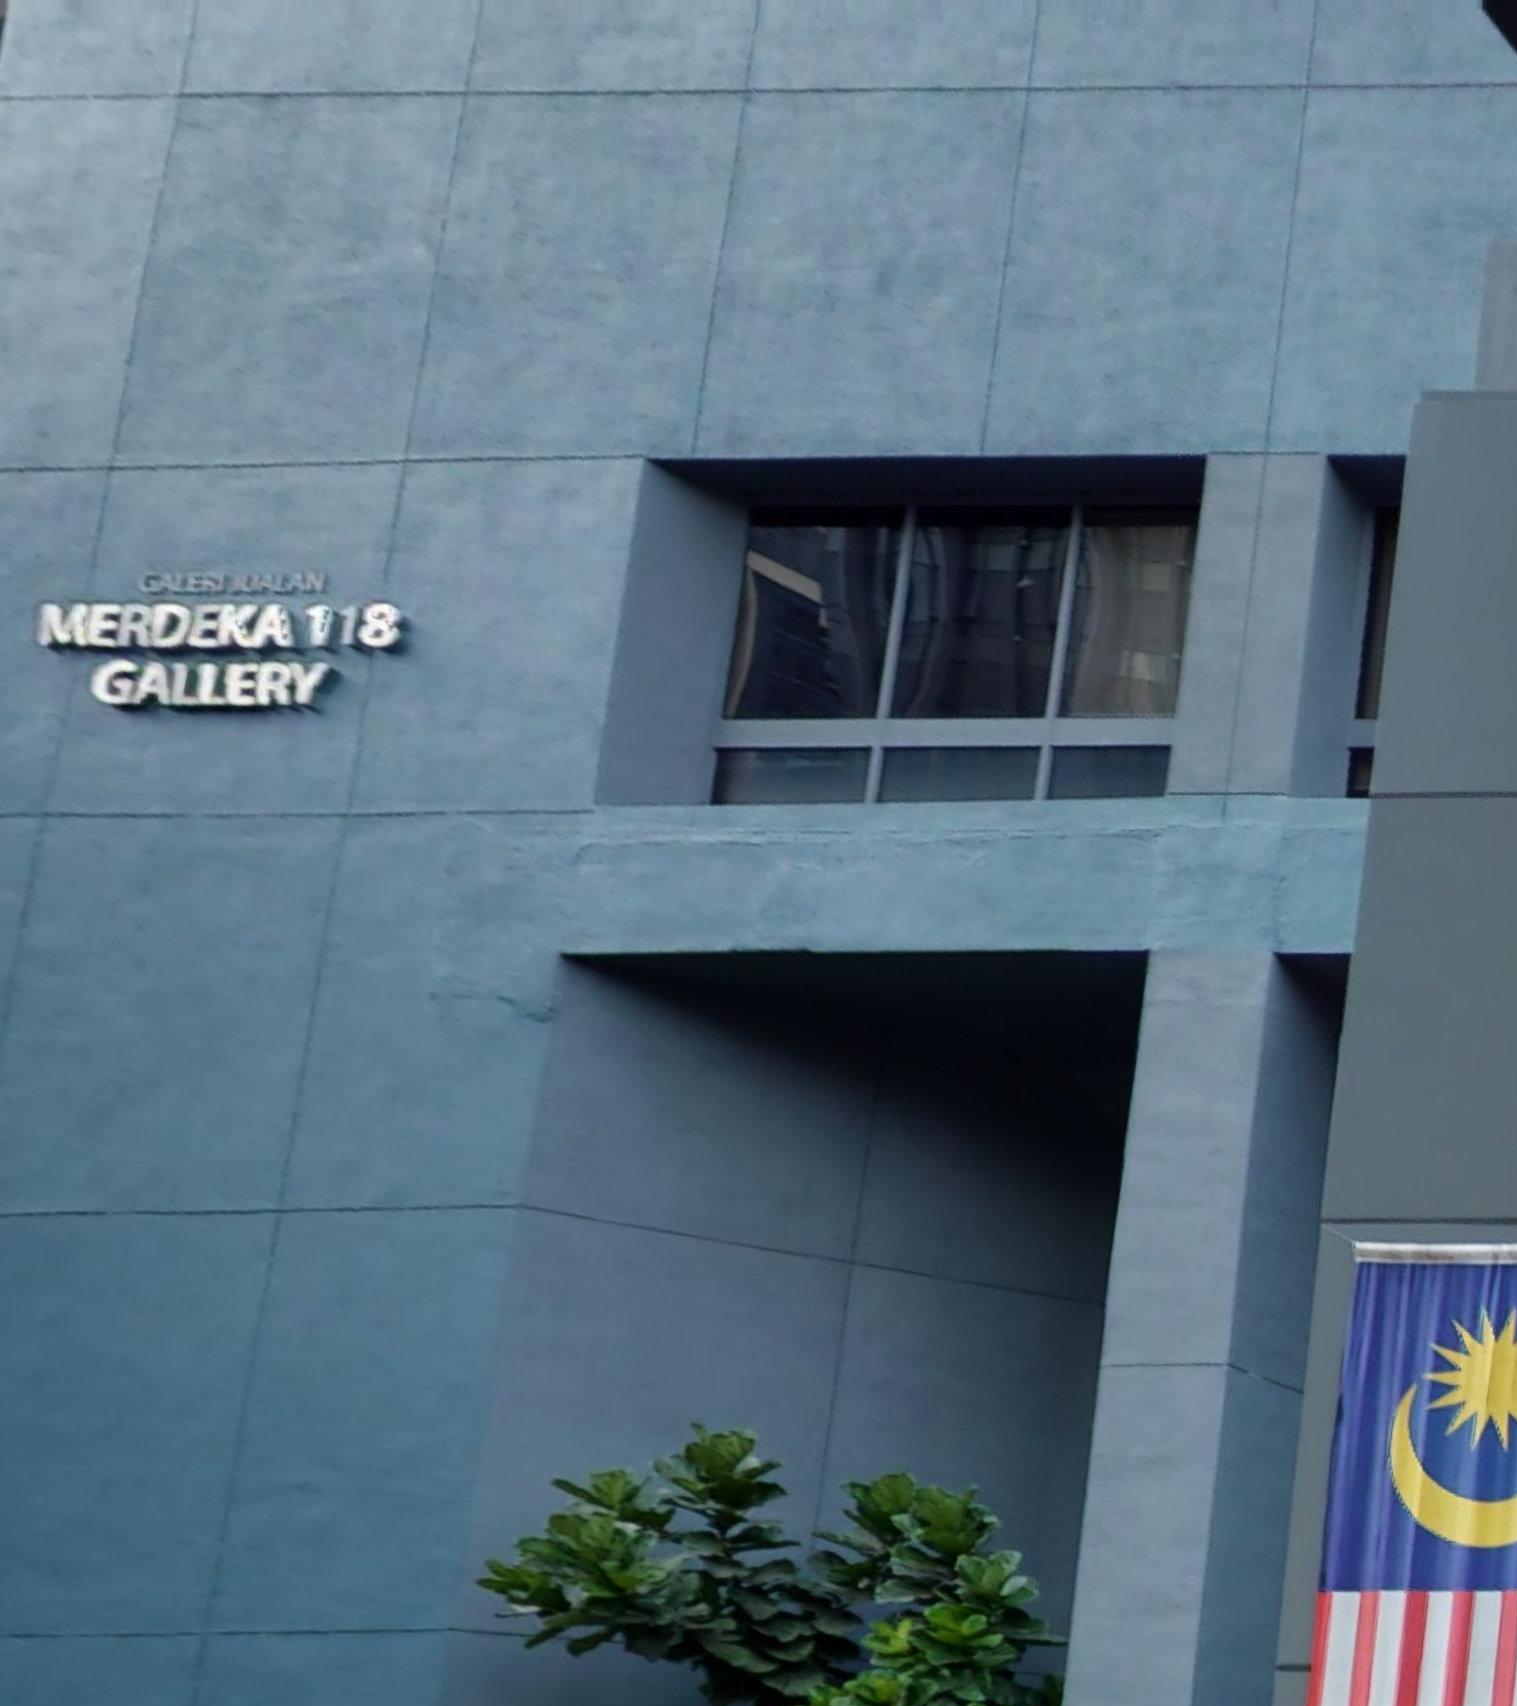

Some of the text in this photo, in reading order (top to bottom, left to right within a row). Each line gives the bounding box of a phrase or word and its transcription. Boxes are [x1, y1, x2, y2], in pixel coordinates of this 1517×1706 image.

[37, 602, 403, 649] MERDEKA 118
[91, 659, 332, 706] GALLERY
